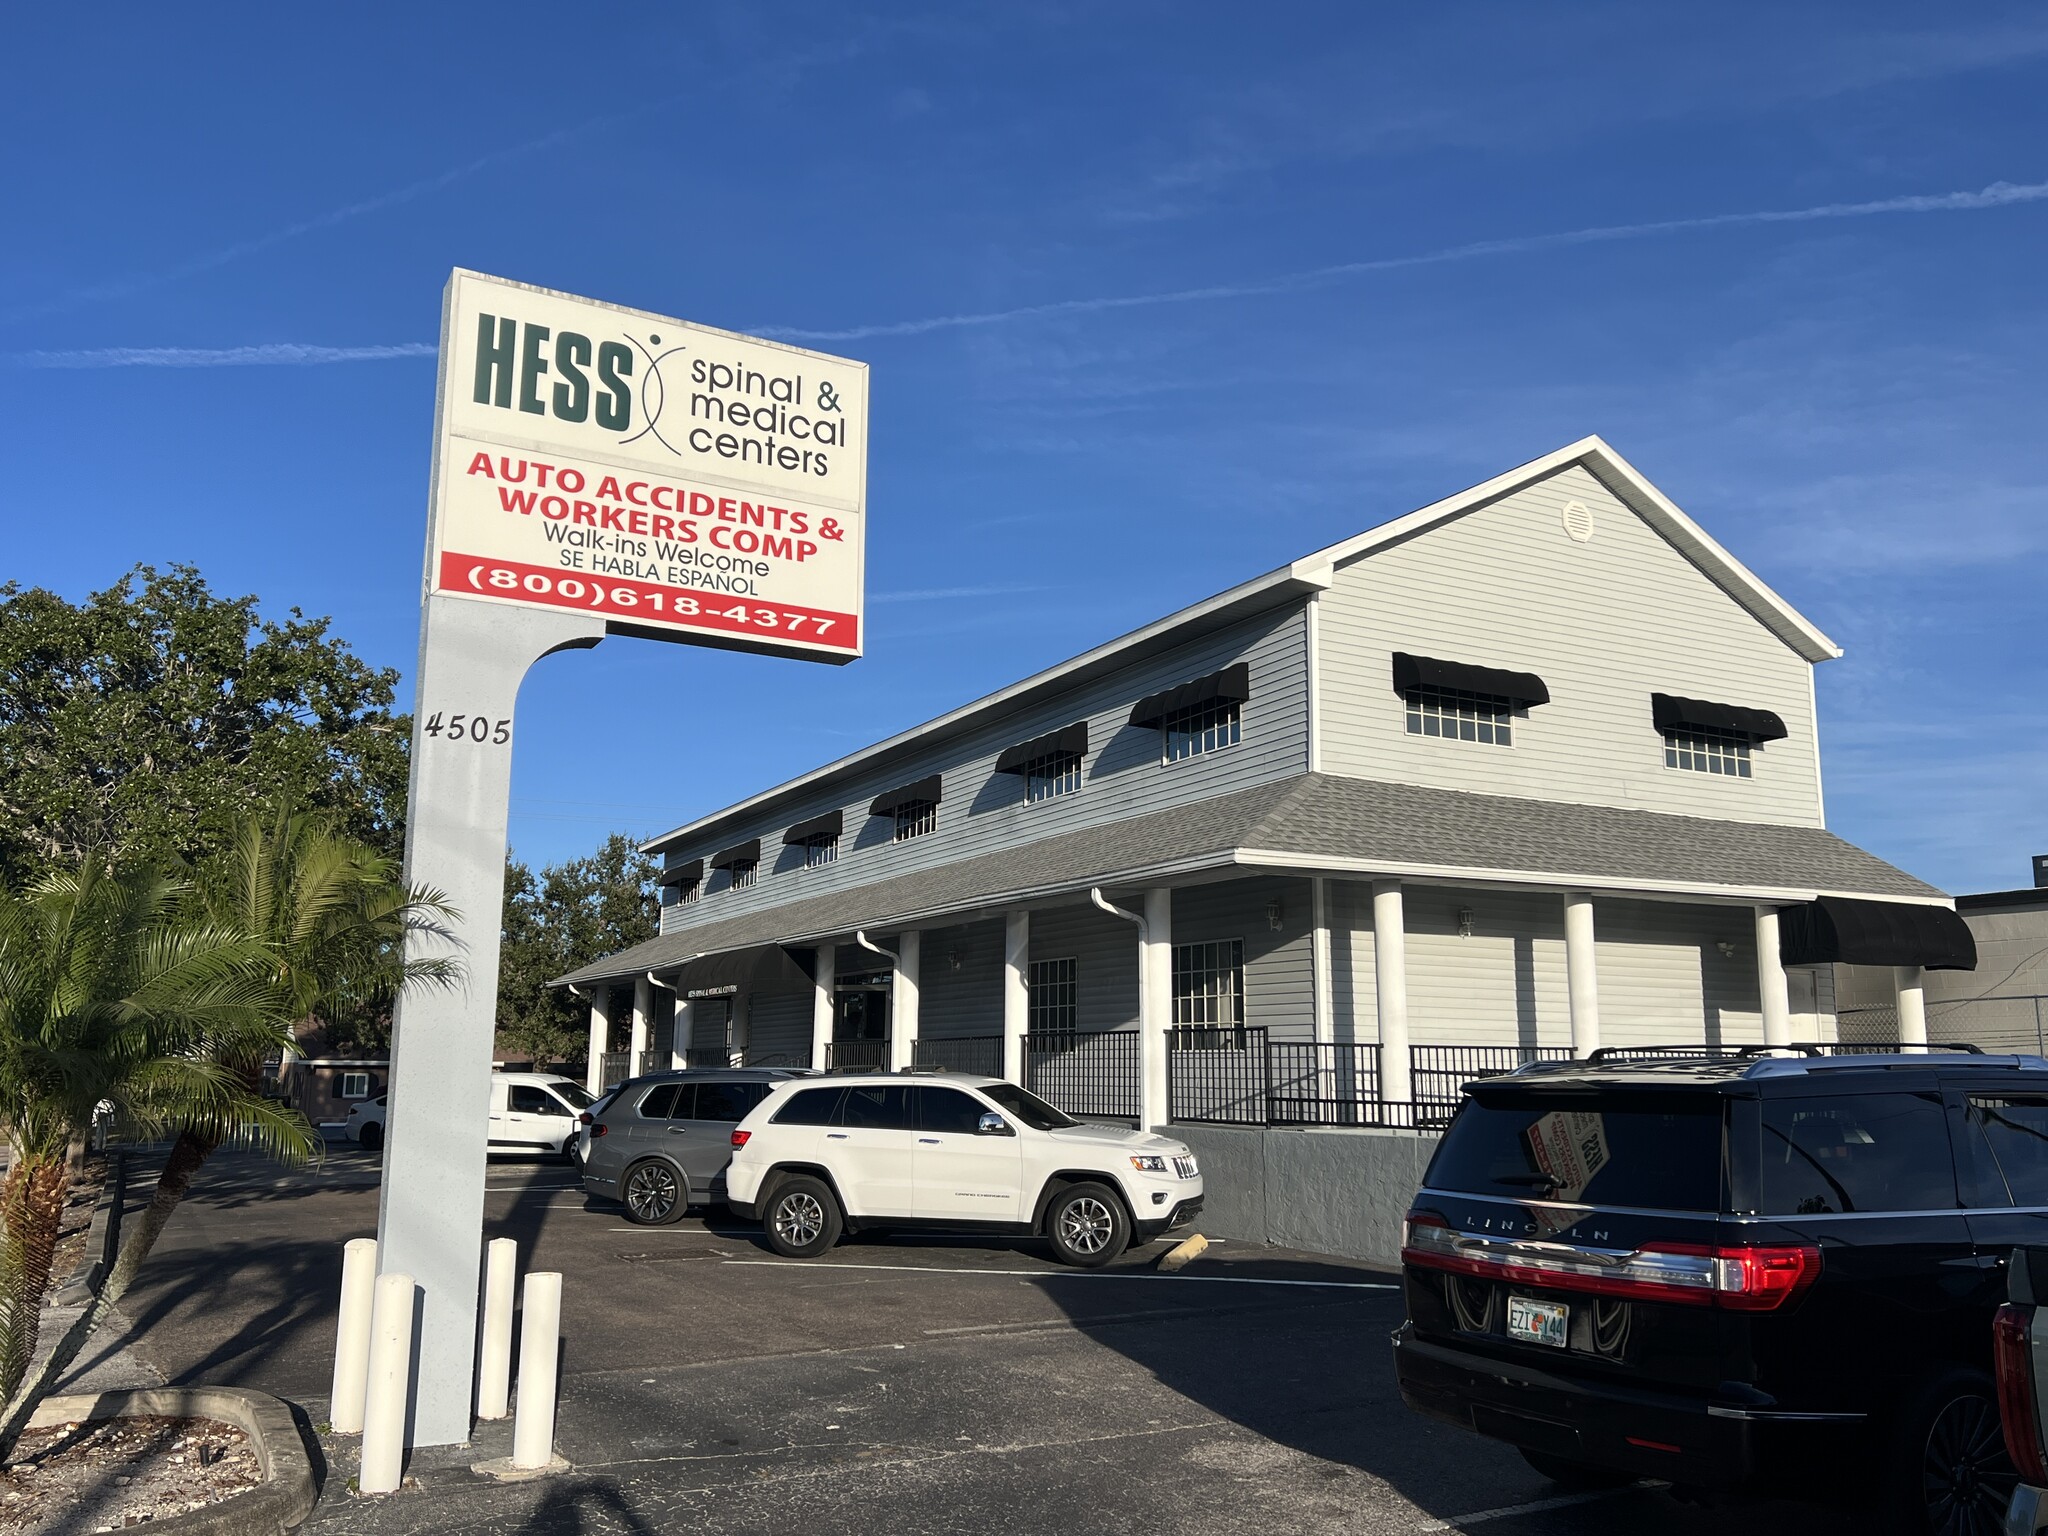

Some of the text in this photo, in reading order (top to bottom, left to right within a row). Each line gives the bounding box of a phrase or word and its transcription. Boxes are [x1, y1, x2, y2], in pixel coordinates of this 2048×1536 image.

[472, 312, 633, 432] HESS
[691, 359, 842, 413] spinal &
[691, 393, 845, 447] medical
[467, 452, 844, 542] AUTO ACCIDENTS &
[497, 486, 818, 562] WORKERS COMP
[543, 521, 770, 577] Walk-ins Welcome
[560, 550, 758, 597] SE HABLA ESPAÑOL
[467, 565, 836, 636] (800)618-4377
[424, 711, 511, 745] 4505
[1466, 1216, 1609, 1241] LINCOLN
